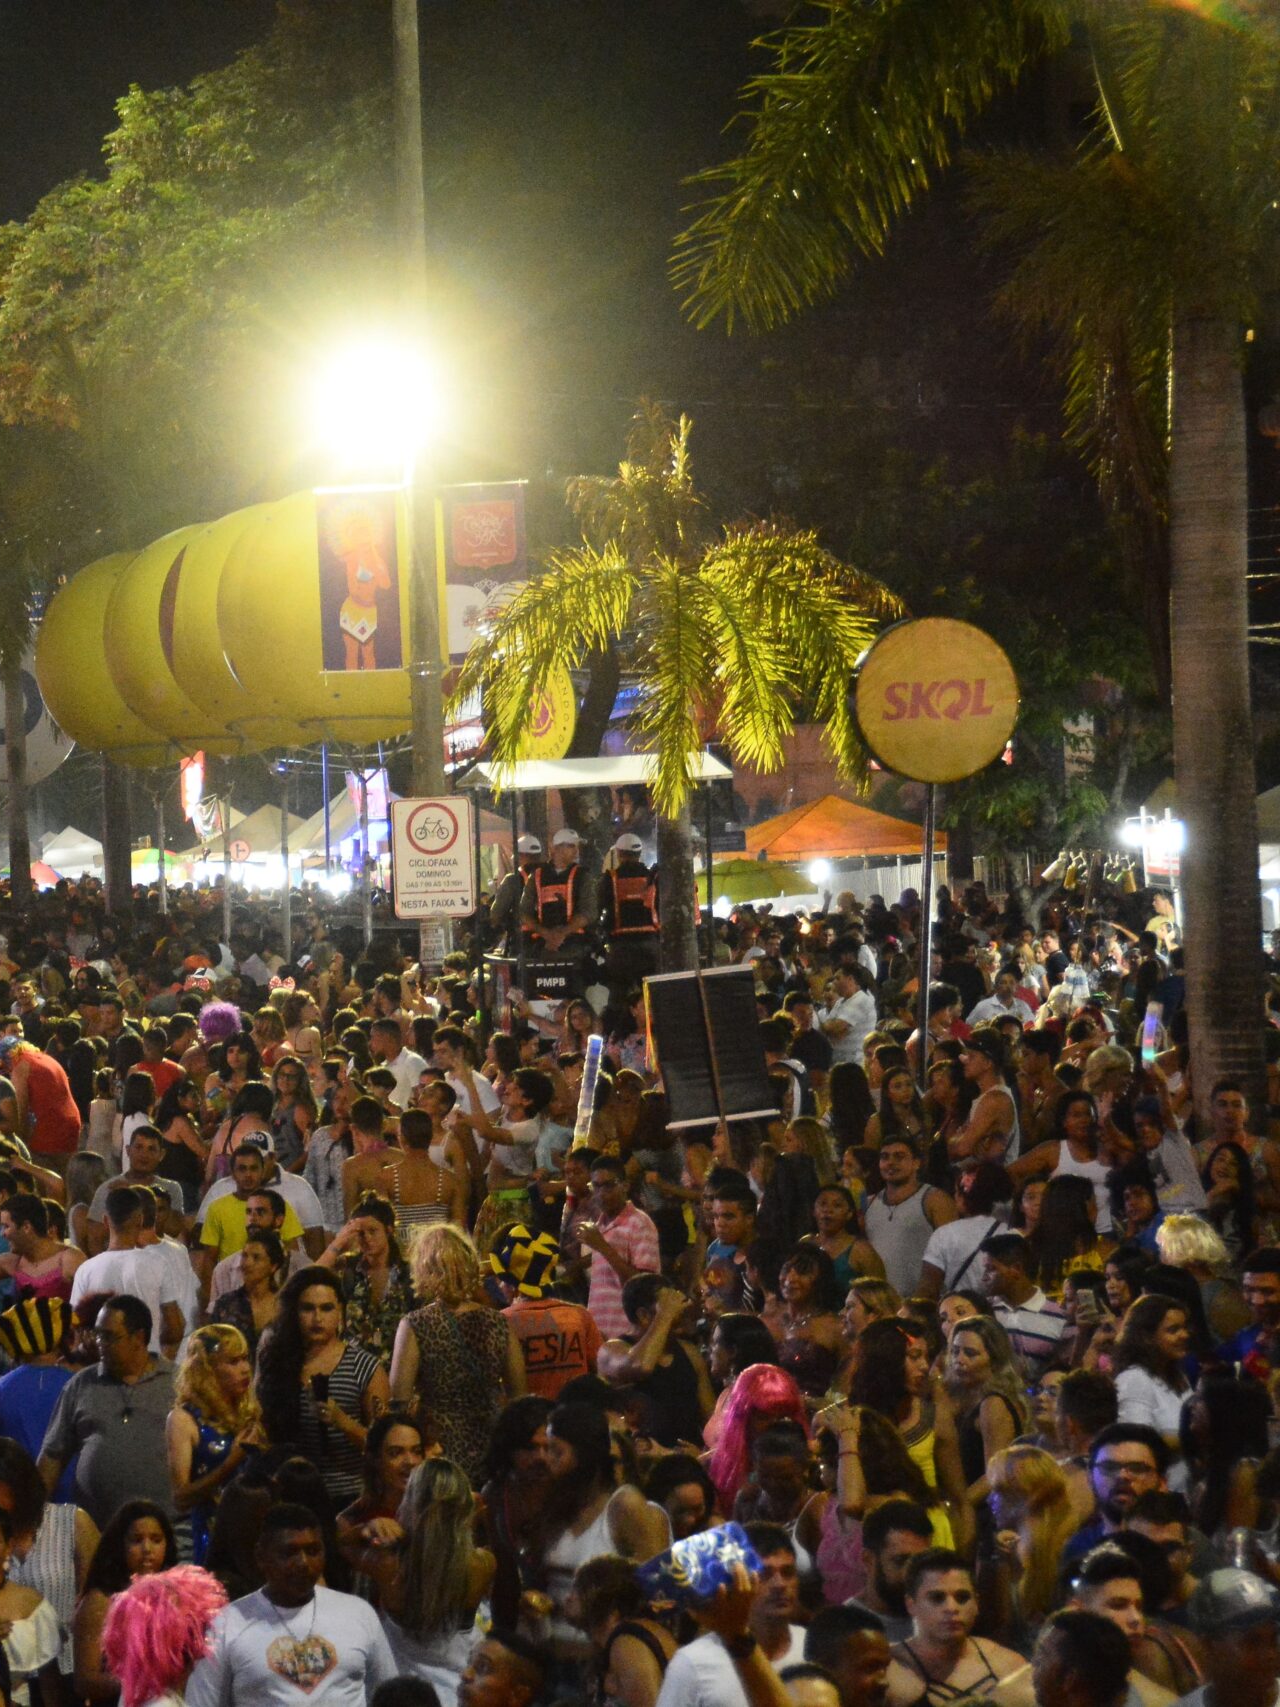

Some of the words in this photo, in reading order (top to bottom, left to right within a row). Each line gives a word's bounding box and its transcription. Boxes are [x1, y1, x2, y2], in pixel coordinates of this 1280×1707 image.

[882, 679, 994, 720] SKOL
[408, 858, 458, 868] CICLOFAIXA
[416, 870, 451, 878] DOMINGO
[401, 900, 428, 909] NESTA
[431, 899, 456, 908] FAIXA
[536, 977, 566, 987] PMPB
[519, 1331, 584, 1364] ESIA
